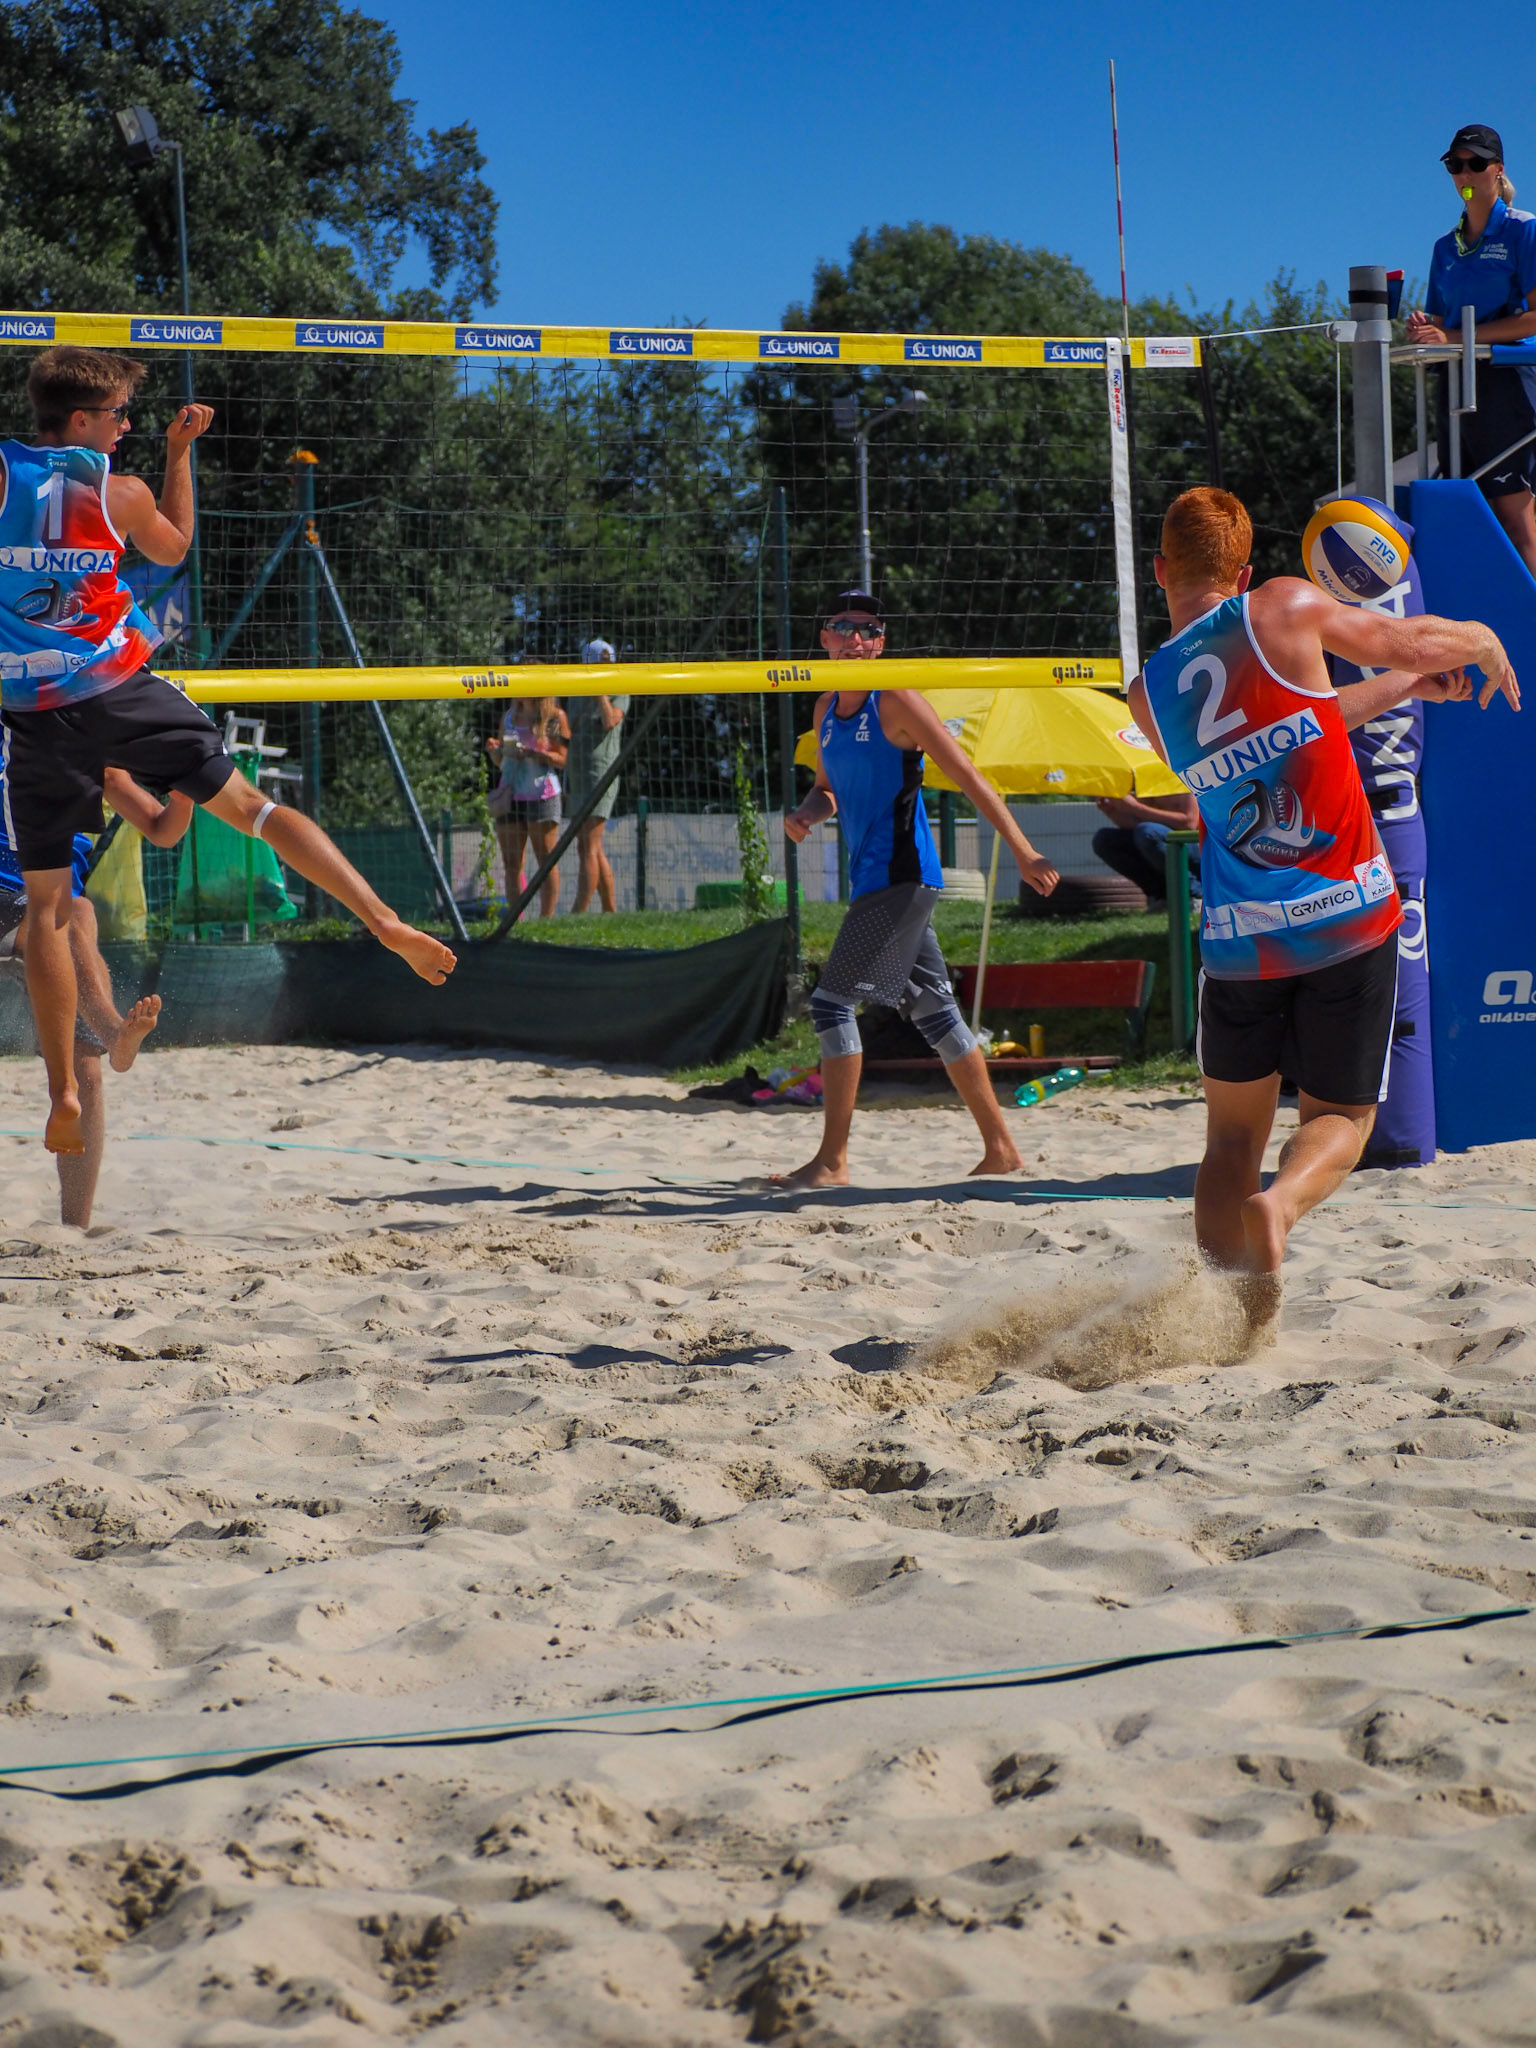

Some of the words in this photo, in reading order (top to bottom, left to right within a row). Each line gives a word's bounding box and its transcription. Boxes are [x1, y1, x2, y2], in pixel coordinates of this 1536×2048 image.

[163, 326, 215, 341] UNIQA
[327, 329, 377, 345] UNIQA
[486, 333, 535, 349] UNIQA
[639, 337, 686, 353] UNIQA
[787, 341, 833, 355] UNIQA
[932, 344, 976, 359] UNIQA
[1070, 347, 1107, 361] UNIQ
[37, 472, 64, 540] 1
[30, 551, 113, 572] UNIQA
[460, 670, 509, 694] gala
[766, 665, 811, 688] gala
[1052, 663, 1093, 684] gala
[1177, 653, 1248, 747] 2
[1361, 580, 1418, 821] UNA
[859, 713, 868, 730] 2
[856, 731, 869, 741] CZE
[1210, 716, 1322, 783] UNIQA
[1291, 890, 1354, 916] GRAFICO
